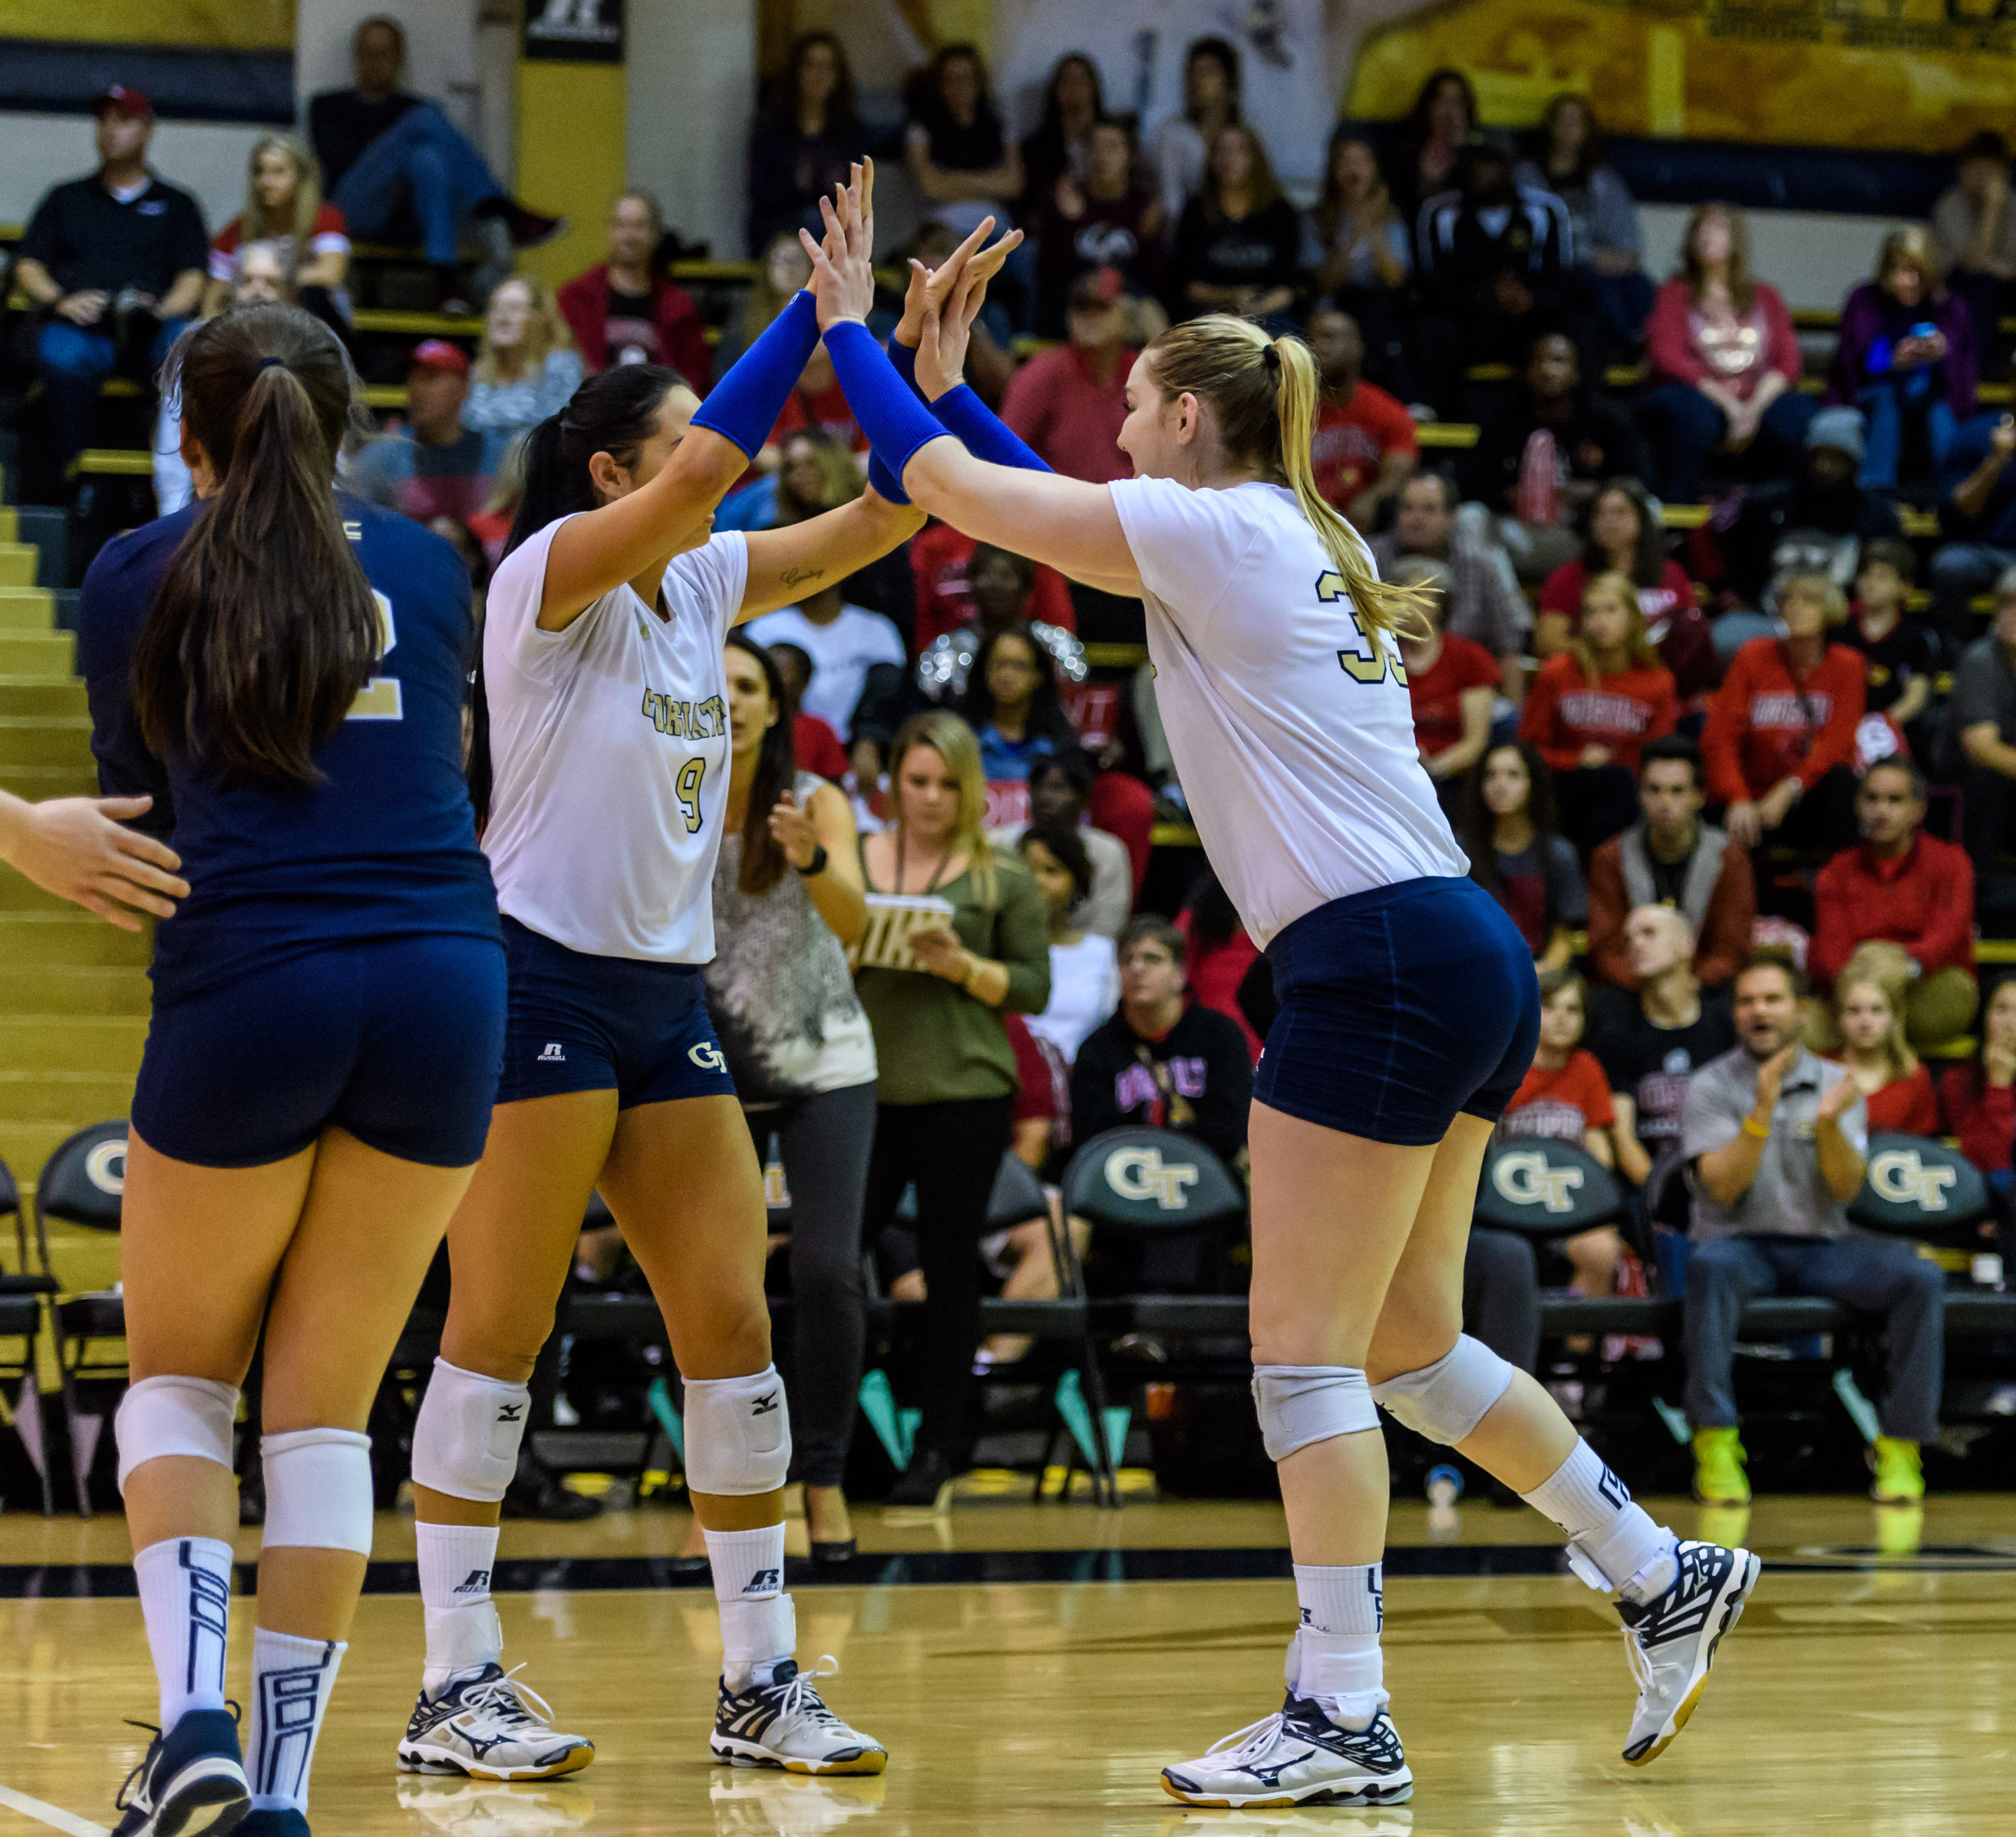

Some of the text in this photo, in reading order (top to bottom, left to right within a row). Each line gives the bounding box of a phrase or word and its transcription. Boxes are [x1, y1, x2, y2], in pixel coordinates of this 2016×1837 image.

[676, 757, 706, 834] 9
[688, 1042, 727, 1073] GT
[1104, 1146, 1199, 1210] GT
[1493, 1151, 1585, 1212] GT
[1868, 1149, 1957, 1211] GT
